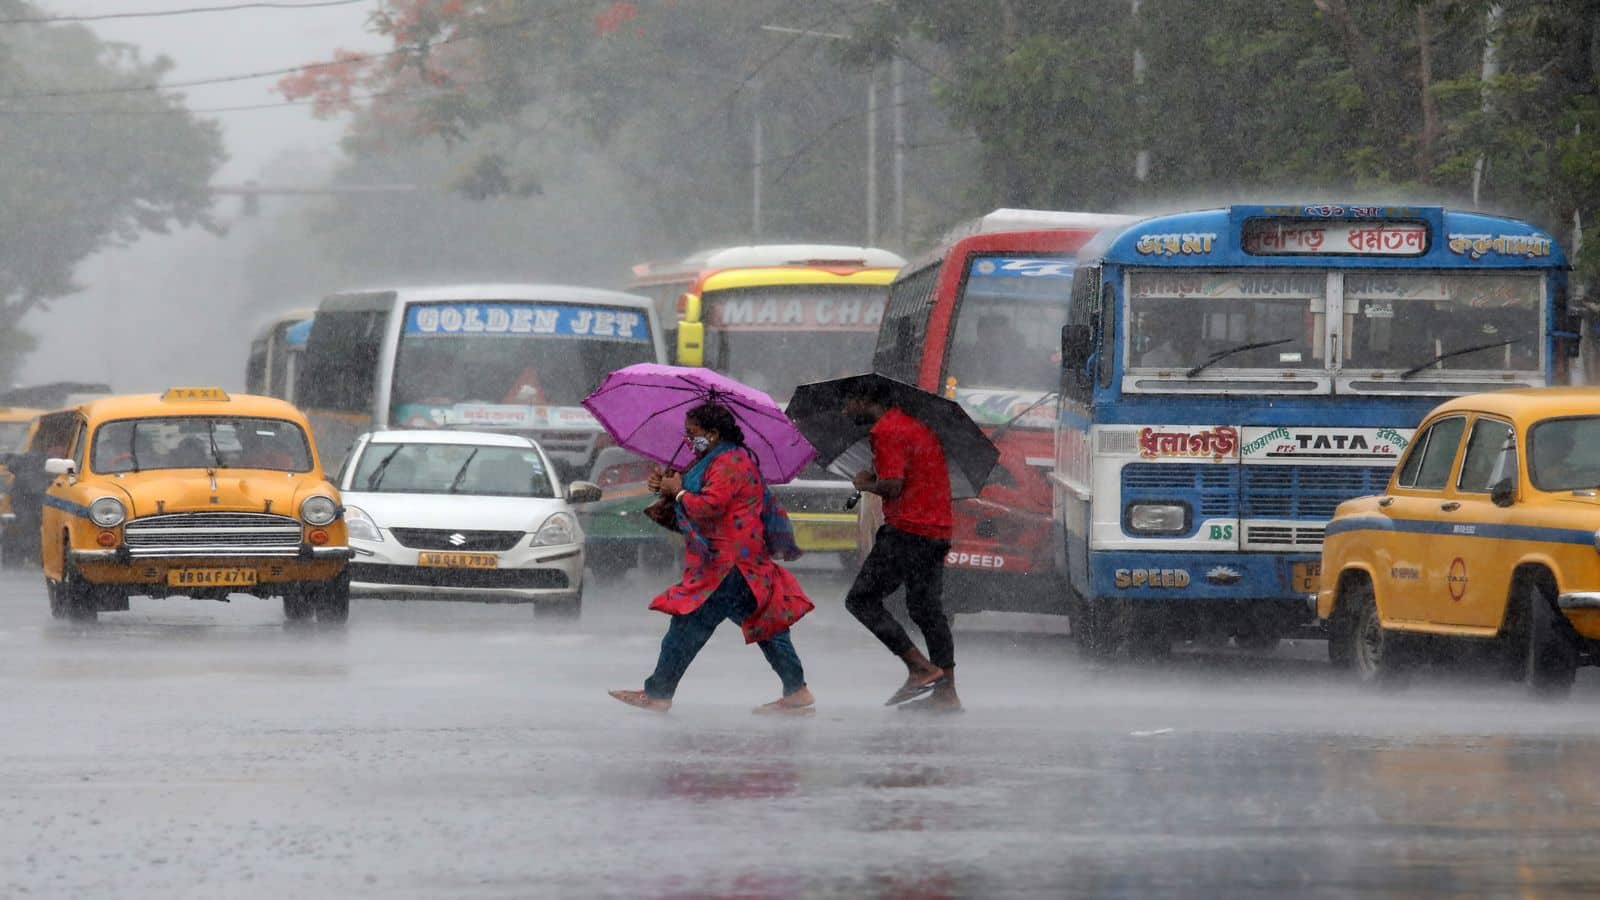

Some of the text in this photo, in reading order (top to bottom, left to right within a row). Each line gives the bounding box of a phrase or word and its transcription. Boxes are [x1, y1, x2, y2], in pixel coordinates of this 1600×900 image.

[722, 301, 802, 325] MAA
[416, 307, 640, 337] GOLDEN JET
[175, 389, 219, 398] TAXI
[1295, 434, 1369, 450] TATA
[1208, 525, 1233, 540] BS
[946, 551, 1005, 568] SPEED
[1115, 567, 1191, 590] SPEED
